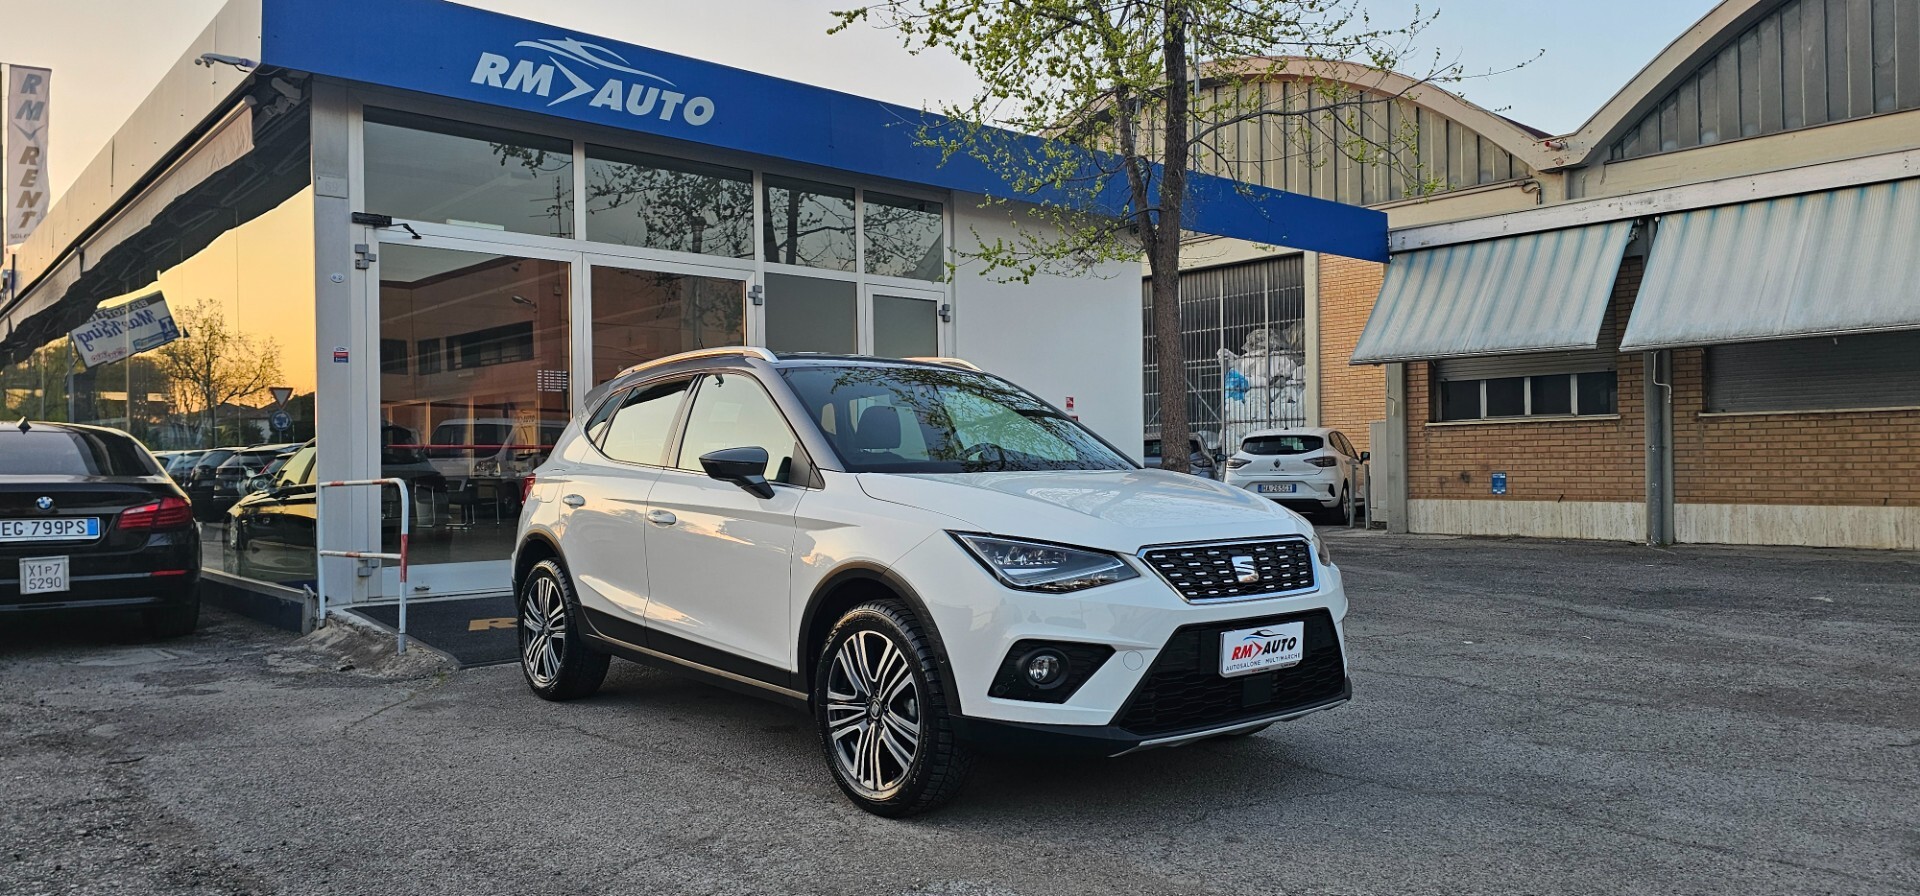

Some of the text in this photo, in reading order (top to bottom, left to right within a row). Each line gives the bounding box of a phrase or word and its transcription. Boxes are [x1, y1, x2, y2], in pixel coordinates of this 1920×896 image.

[470, 51, 715, 126] RM AUTO
[16, 146, 43, 229] RENT
[2, 520, 86, 536] EG 799PS
[29, 577, 62, 590] 5290
[1231, 636, 1297, 660] RM AUTO
[1225, 660, 1262, 672] AUTOSALONE
[1265, 653, 1301, 664] MULTIMARCHE
